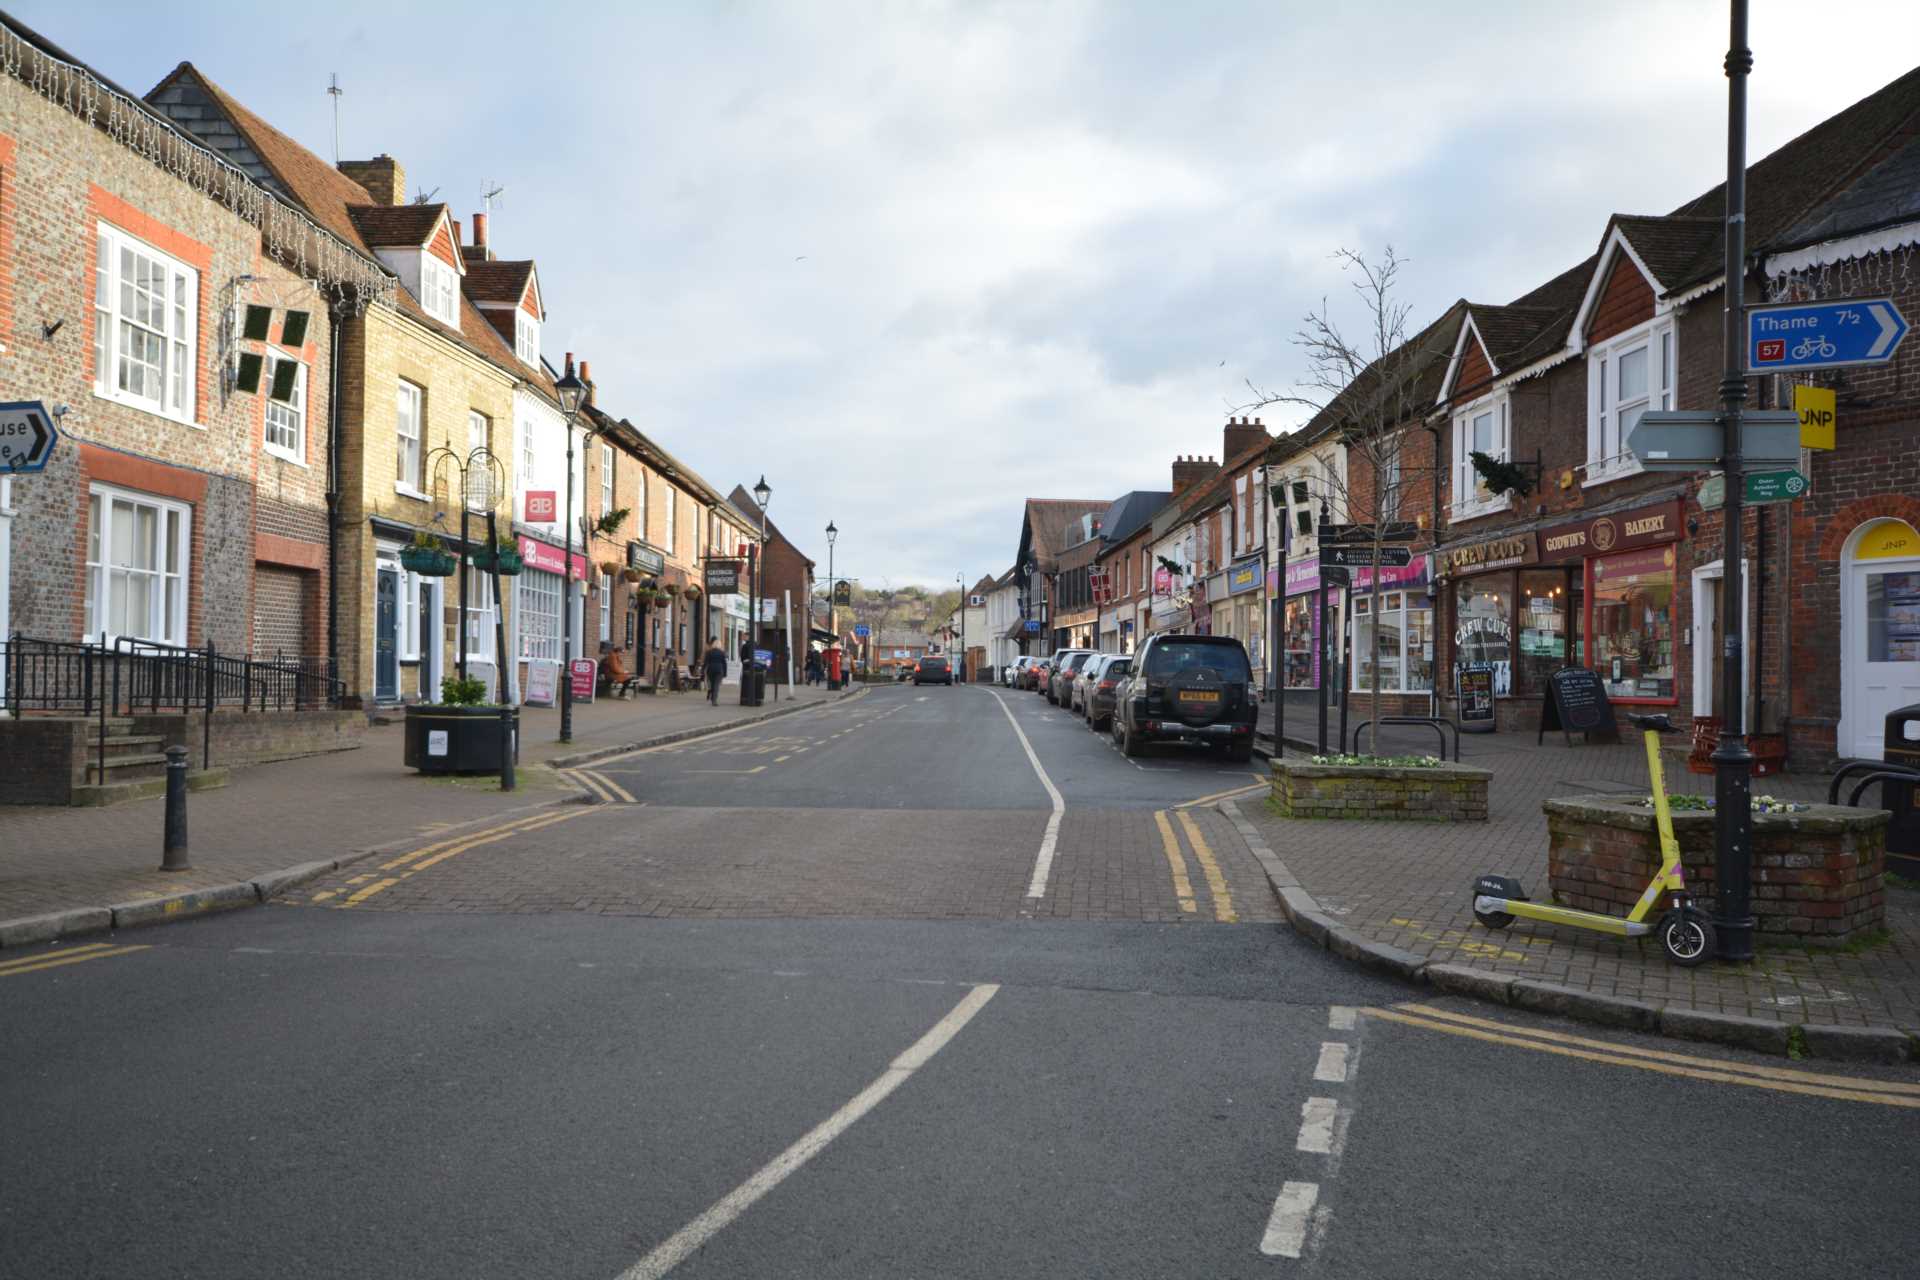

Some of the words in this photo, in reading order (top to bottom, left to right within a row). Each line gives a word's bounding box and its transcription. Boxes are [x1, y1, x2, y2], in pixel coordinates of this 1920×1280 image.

[1758, 316, 1818, 331] Thame
[1762, 344, 1780, 356] 57
[1800, 407, 1833, 427] JNP
[1546, 531, 1586, 552] GODWIN'S
[1625, 515, 1665, 537] BAKERY
[1453, 543, 1487, 567] CREW
[1488, 538, 1526, 560] CUTS
[1881, 539, 1907, 550] JNP
[1455, 615, 1483, 646] CREW
[1487, 616, 1512, 643] CUTS
